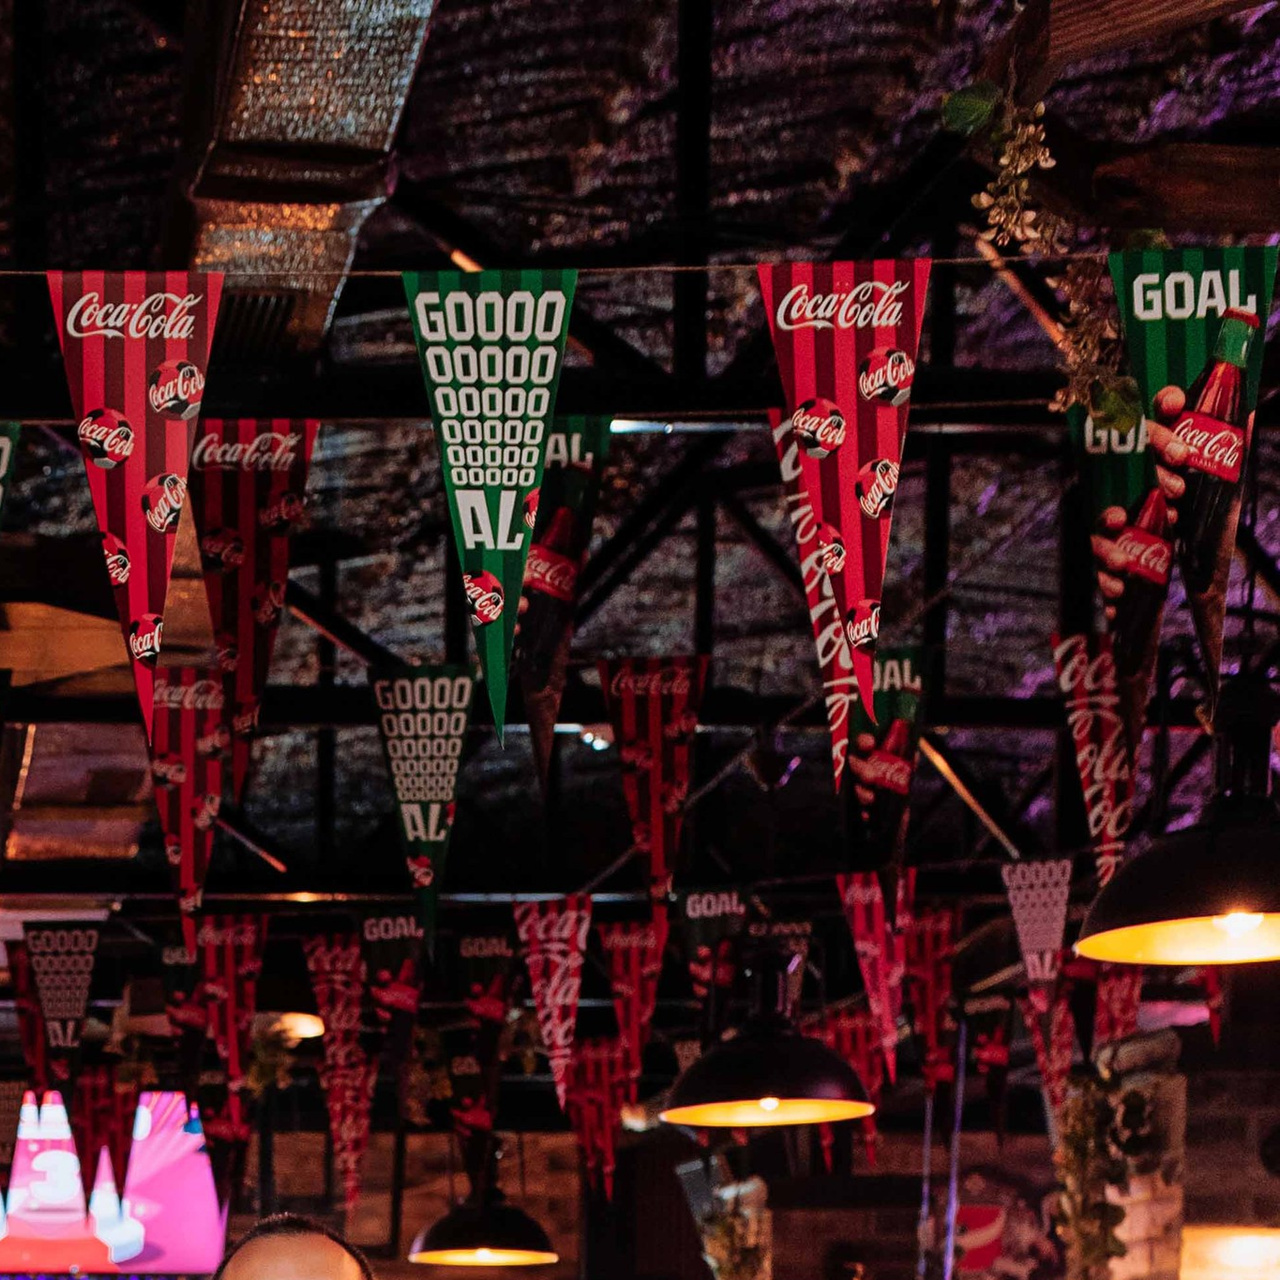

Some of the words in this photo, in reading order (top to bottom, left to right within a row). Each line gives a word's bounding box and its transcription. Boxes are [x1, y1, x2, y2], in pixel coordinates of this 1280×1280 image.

[66, 291, 203, 339] Coca-Cola
[776, 280, 910, 330] Coca-Cola
[1133, 268, 1257, 321] GOAL
[192, 431, 302, 472] Coca-Cola
[454, 489, 525, 550] AL
[29, 1149, 82, 1201] 3
